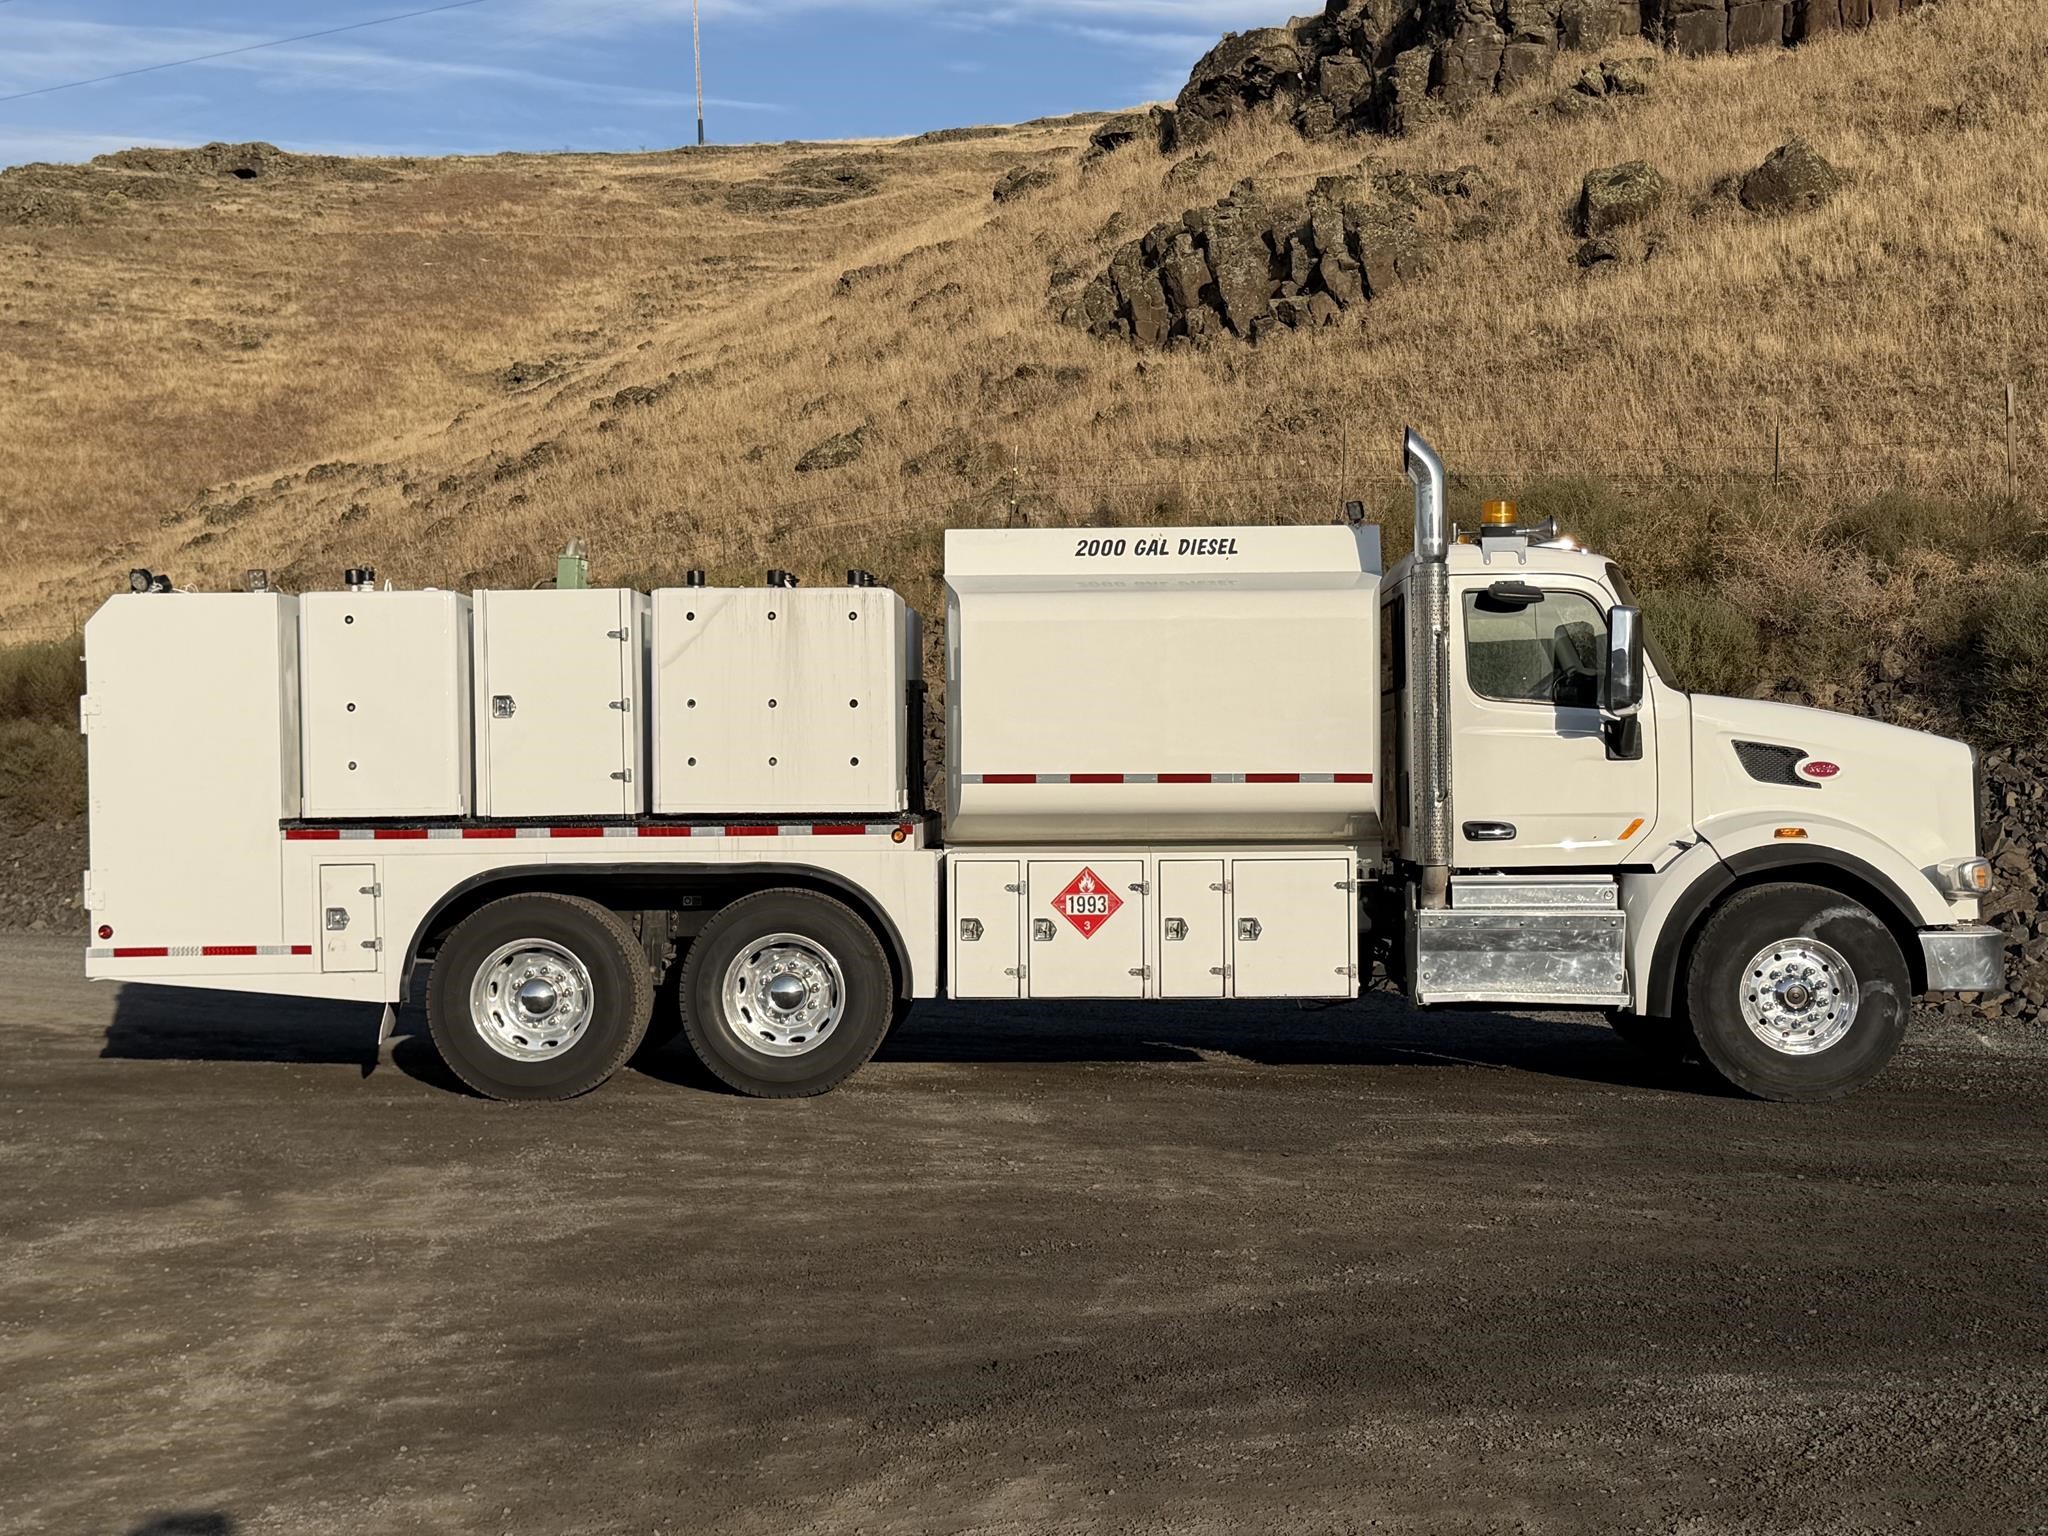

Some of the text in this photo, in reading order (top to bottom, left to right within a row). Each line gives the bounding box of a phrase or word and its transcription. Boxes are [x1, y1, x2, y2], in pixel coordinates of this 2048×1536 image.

[1075, 538, 1238, 556] 2000 GAL DIESEL
[1068, 895, 1107, 914] 1993
[1083, 920, 1091, 930] 3
